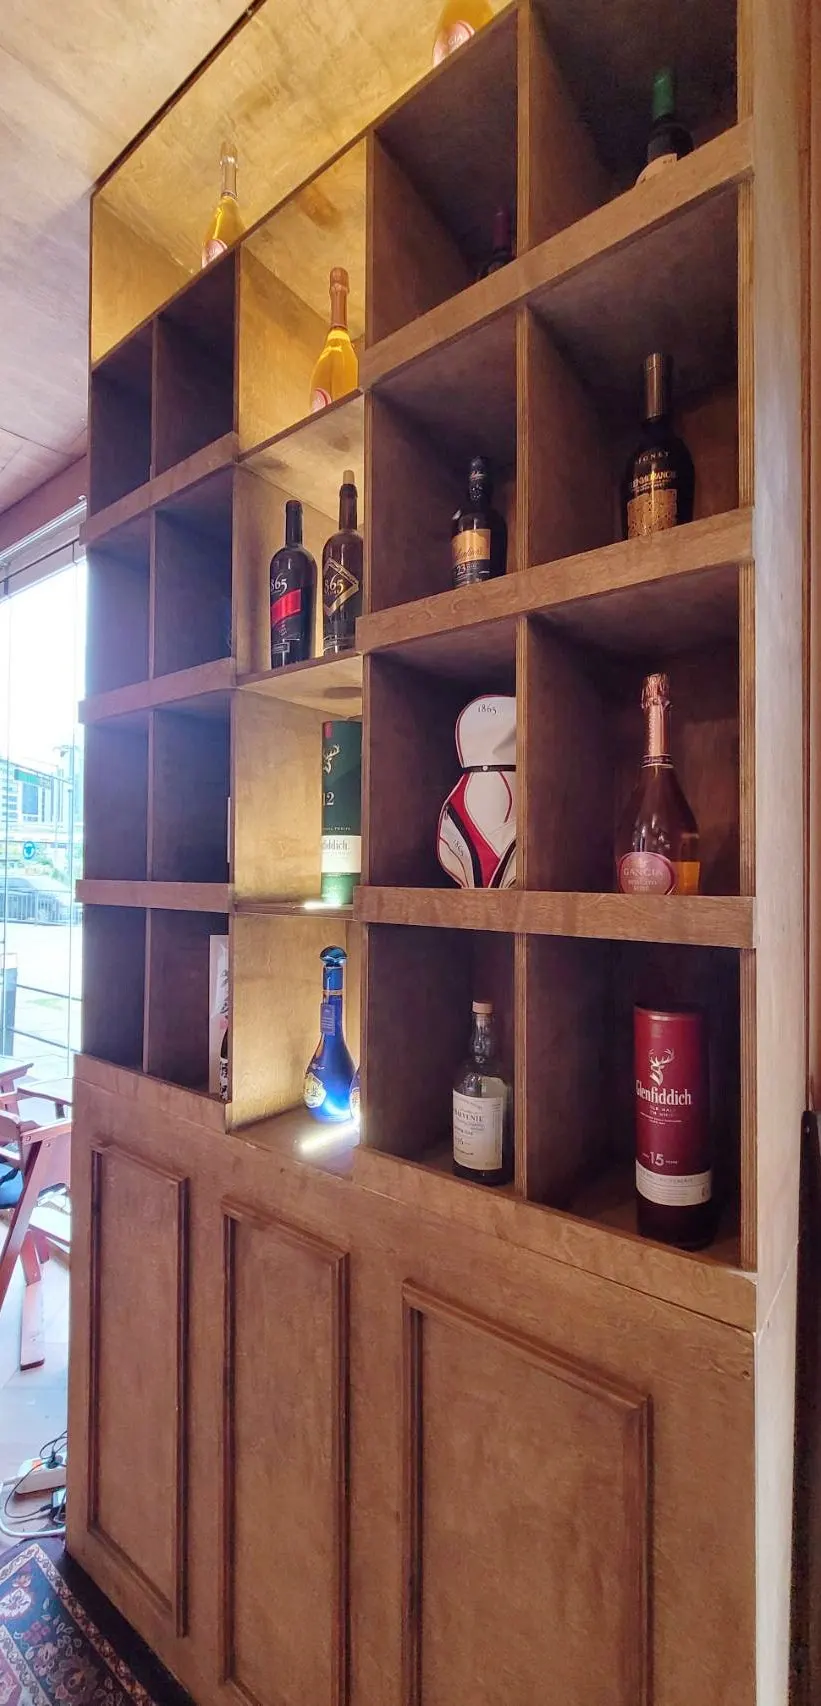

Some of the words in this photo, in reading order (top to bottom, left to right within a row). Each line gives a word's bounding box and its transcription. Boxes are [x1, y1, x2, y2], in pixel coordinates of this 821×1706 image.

[478, 704, 497, 715] 1865
[623, 867, 664, 878] GANCIA
[636, 1079, 692, 1106] Glenfiddich
[650, 1151, 664, 1167] 15
